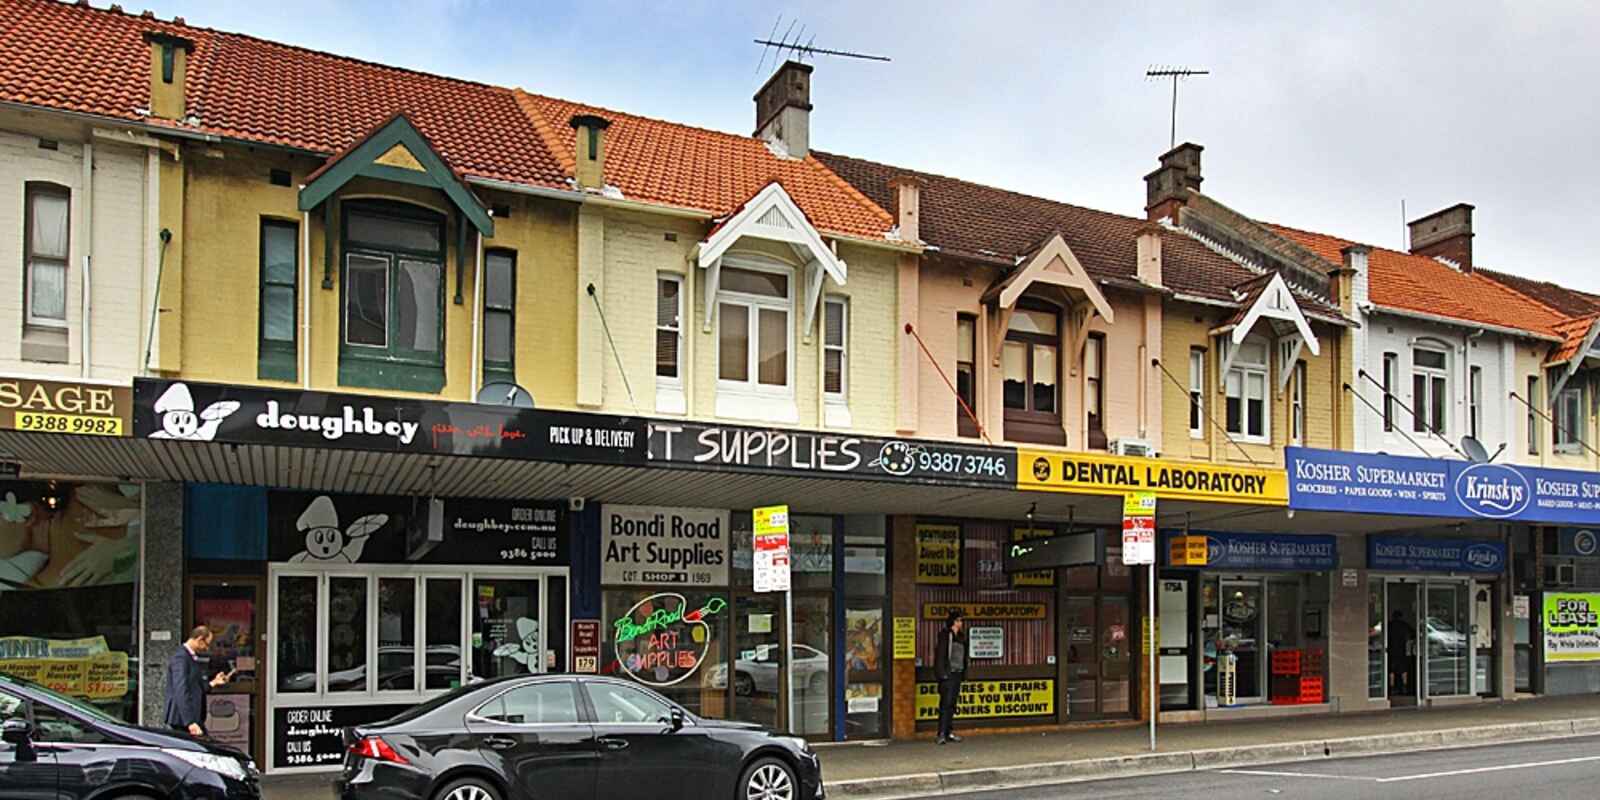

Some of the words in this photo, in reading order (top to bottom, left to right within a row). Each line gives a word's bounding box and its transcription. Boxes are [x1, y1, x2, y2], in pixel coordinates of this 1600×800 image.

[0, 382, 114, 416] SAGE
[22, 415, 68, 431] 9388
[73, 418, 117, 434] 9982
[256, 400, 419, 444] doughboy
[550, 426, 570, 444] PICK
[572, 428, 584, 444] UP
[585, 428, 593, 446] &
[595, 430, 635, 448] DELIVERY
[694, 428, 861, 471] SUPPLIES
[919, 451, 964, 471] 9387
[967, 454, 1006, 476] 3746
[1063, 461, 1139, 486] DENTAL
[1147, 467, 1266, 494] LABORATORY
[1296, 459, 1352, 481] KOSHER
[1357, 465, 1446, 488] SUPERMARKET
[1297, 484, 1336, 495] GROCERIES
[1345, 487, 1366, 496] PAPER
[1368, 488, 1392, 498] GOODS
[1399, 490, 1416, 499] WINE
[1423, 491, 1446, 500] SPIRITS
[1466, 476, 1522, 510] Krinskys
[1536, 478, 1579, 497] KOSHER
[534, 509, 556, 522] ONLINE
[454, 518, 556, 533] doughboy.com.au
[611, 514, 664, 537] Bondi
[671, 516, 720, 539] Road
[531, 537, 546, 550] CALL
[548, 537, 556, 550] US
[1227, 539, 1266, 554] KOSHER
[1270, 541, 1332, 556] SUPERMARKET
[1375, 543, 1407, 556] KOSHER
[1409, 545, 1460, 558] SUPERMARKET
[500, 548, 527, 559] 9386
[530, 551, 556, 560] 5000
[605, 540, 641, 563] Art
[646, 541, 723, 569] Supplies
[644, 573, 676, 581] SHOP
[918, 563, 957, 576] PUBLIC
[973, 607, 1040, 617] LABORATORY
[1558, 600, 1587, 612] FOR
[614, 616, 651, 642] Bondi
[652, 602, 682, 629] Road
[1549, 612, 1597, 626] LEASE
[648, 630, 679, 650] ART
[578, 658, 594, 668] 179
[920, 684, 984, 694] DERES
[1000, 682, 1047, 692] REPAIRS
[957, 694, 975, 705] ILE
[979, 693, 1000, 704] YOU
[1004, 693, 1030, 704] WAIT
[288, 710, 308, 723] ORDER
[310, 710, 333, 722] ONLINE
[920, 704, 991, 717] PENONERS
[995, 703, 1048, 714] DISCOUNT
[288, 742, 301, 753] CALL
[303, 741, 311, 752] US
[288, 755, 314, 763] 9386
[316, 753, 342, 762] 5000
